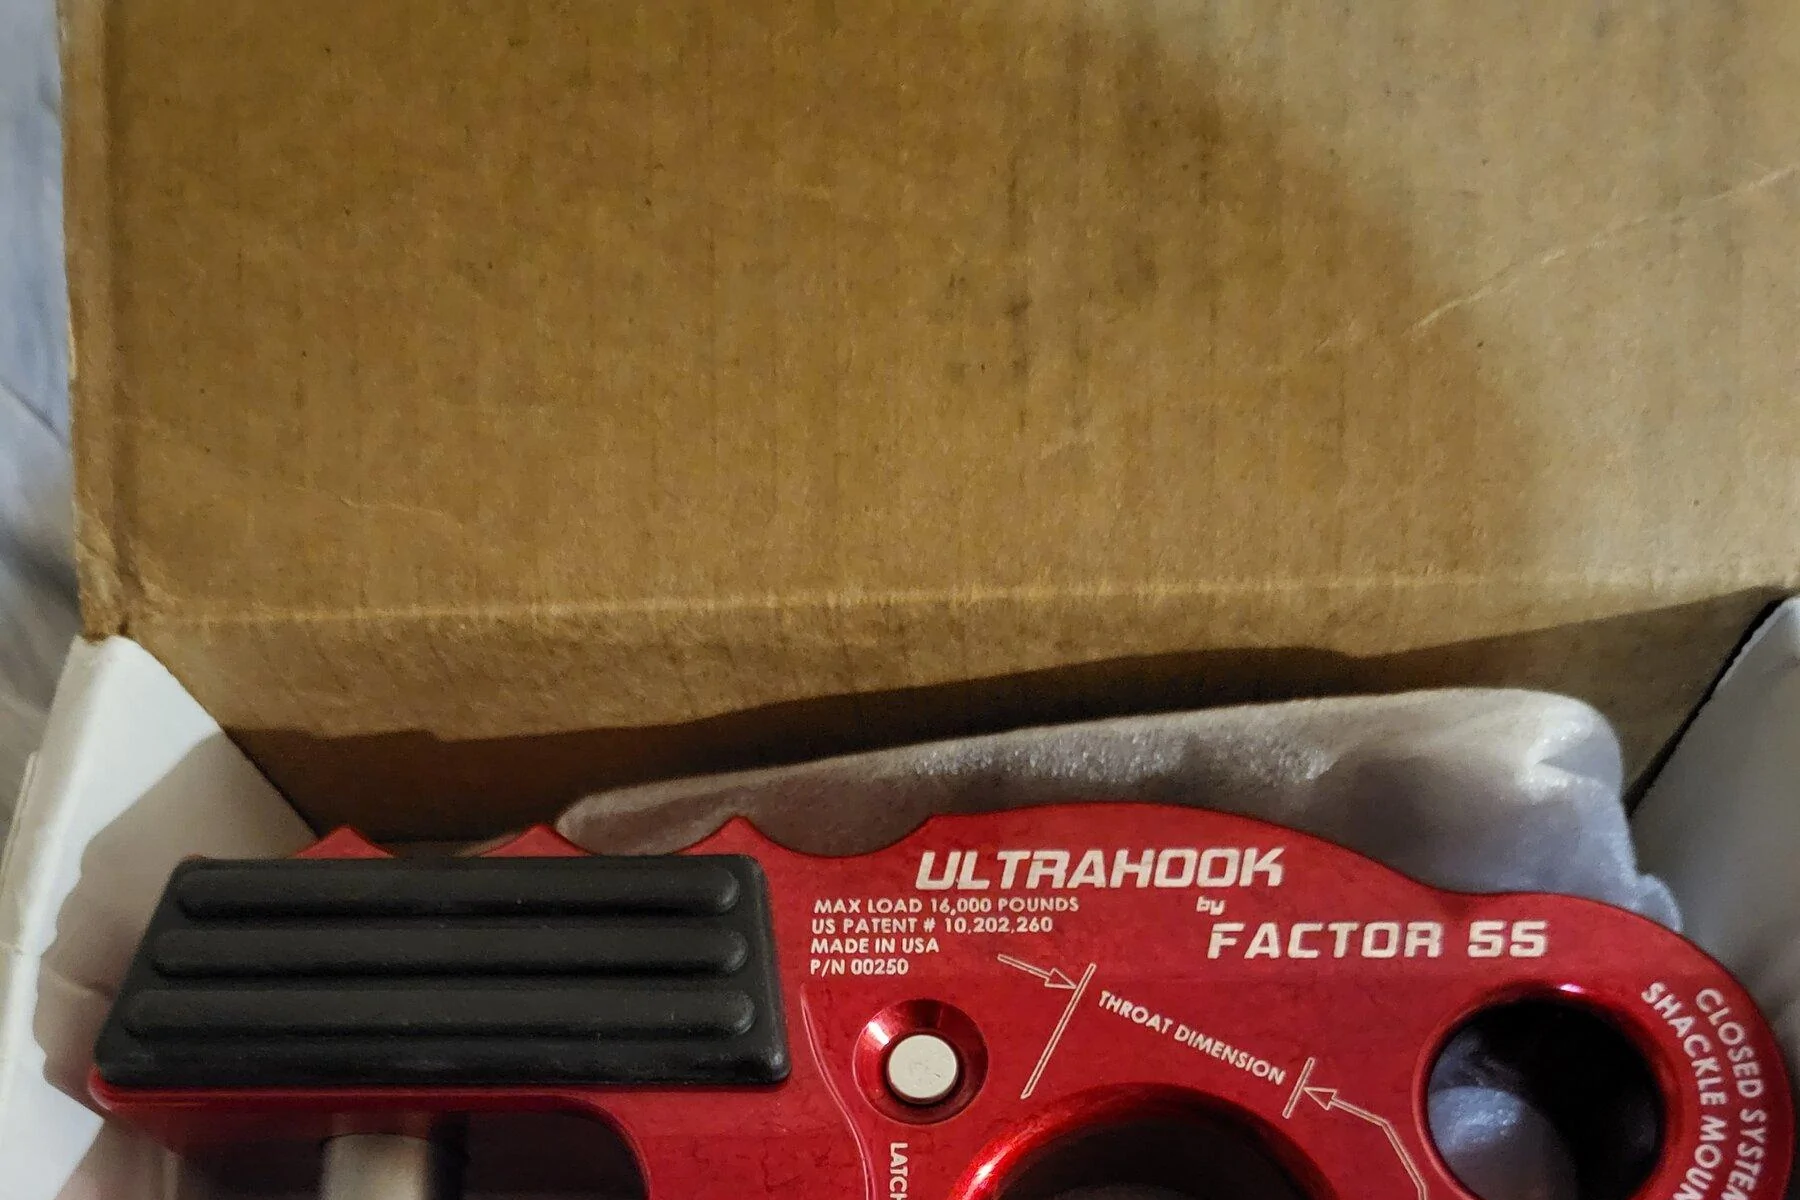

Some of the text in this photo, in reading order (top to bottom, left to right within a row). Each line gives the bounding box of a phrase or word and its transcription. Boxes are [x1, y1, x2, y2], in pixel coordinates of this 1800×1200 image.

[915, 847, 1285, 890] ULTRAHOOK
[814, 897, 1079, 916] MAX LOAD 16,000 POUNDS
[1196, 895, 1225, 915] by
[811, 917, 1053, 935] US PATENT # 10,202,260
[1207, 920, 1548, 959] FACTOR 55
[811, 937, 940, 954] MADE IN USA
[810, 958, 909, 977] P/N 00250
[1099, 990, 1287, 1086] THROAT DIMENSION
[1641, 981, 1727, 1106] SHACKLE
[1696, 988, 1765, 1098] CLOSED
